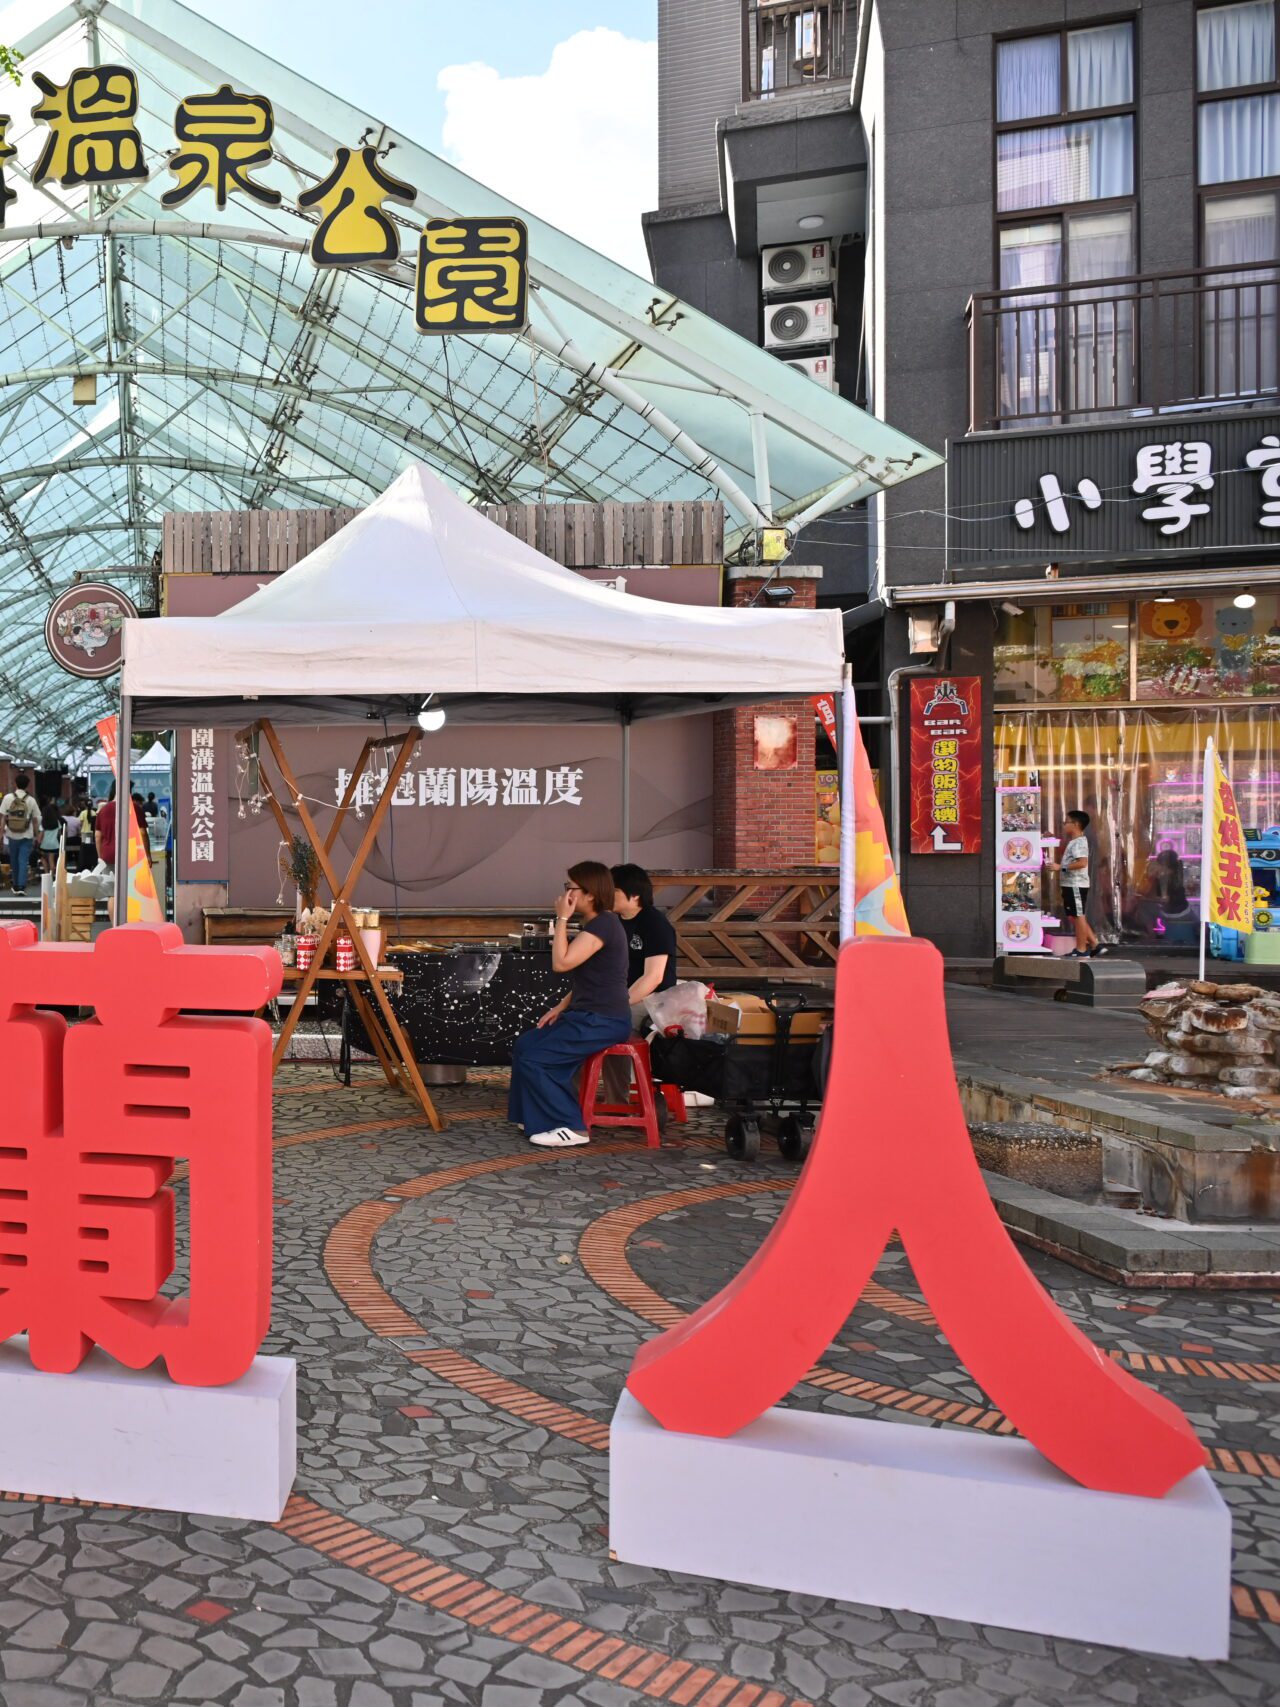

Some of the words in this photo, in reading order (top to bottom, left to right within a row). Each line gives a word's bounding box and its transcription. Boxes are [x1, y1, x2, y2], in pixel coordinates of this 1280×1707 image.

[817, 695, 835, 724] 宜
[933, 739, 959, 823] 選物販賣機
[626, 935, 1206, 1498] 人
